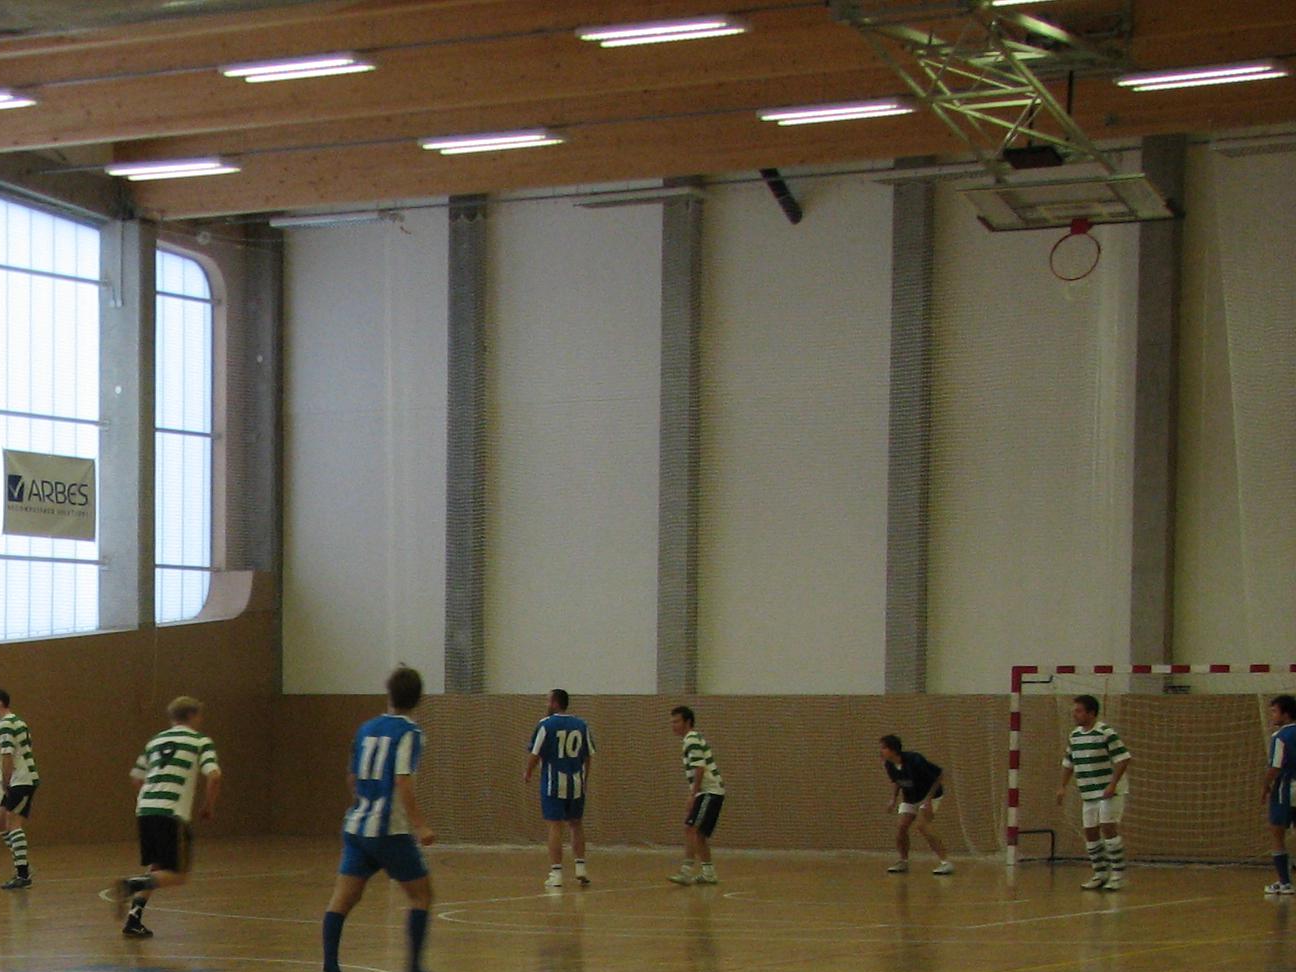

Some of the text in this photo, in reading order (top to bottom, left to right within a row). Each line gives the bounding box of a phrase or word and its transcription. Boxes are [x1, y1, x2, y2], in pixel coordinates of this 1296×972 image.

[27, 479, 89, 506] ARBES
[357, 735, 392, 781] 11
[556, 730, 583, 759] 10
